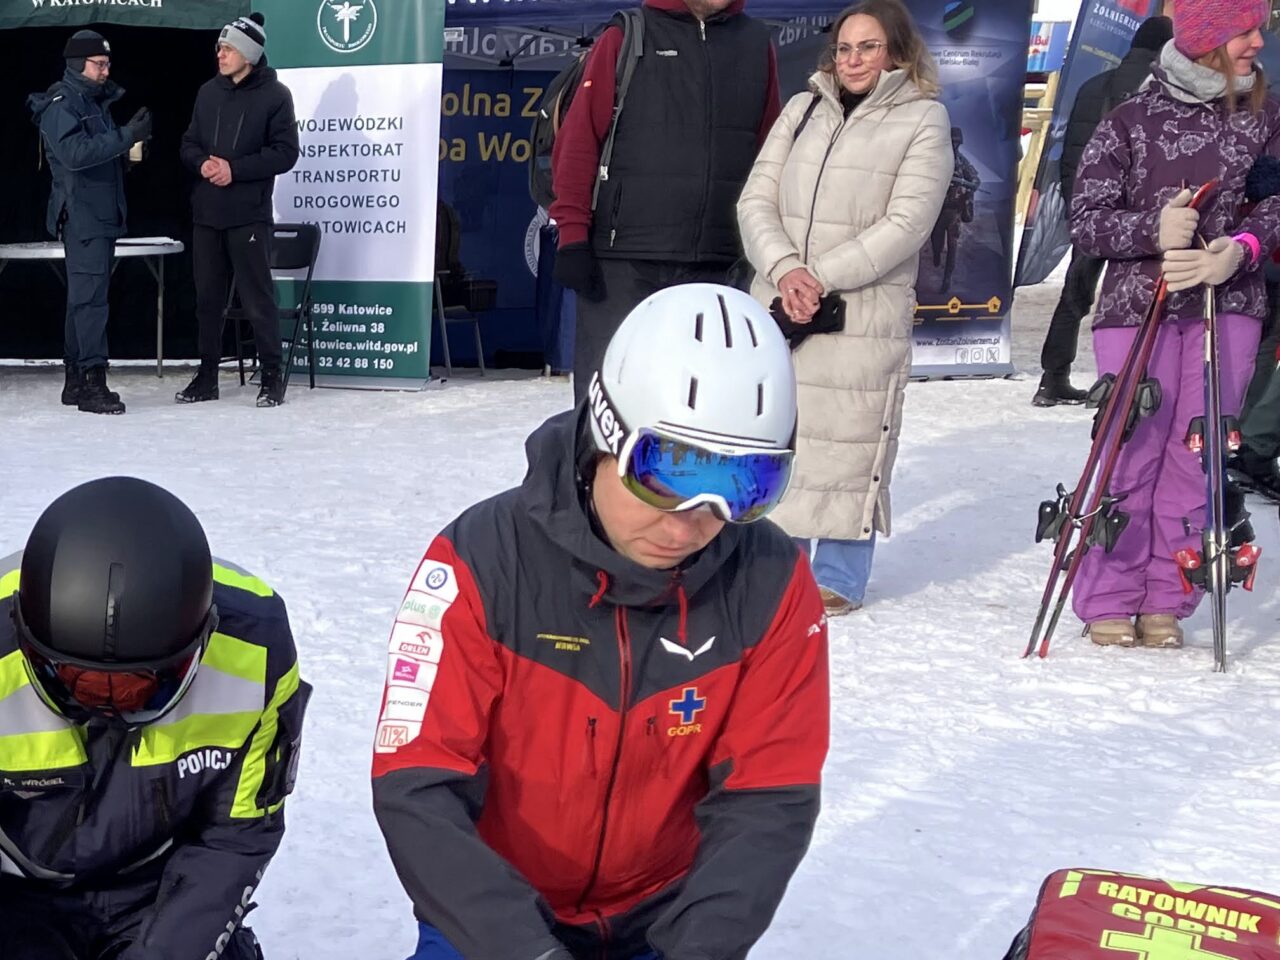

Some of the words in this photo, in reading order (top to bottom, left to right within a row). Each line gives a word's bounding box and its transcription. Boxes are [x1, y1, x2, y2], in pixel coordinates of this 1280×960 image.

[442, 83, 510, 117] olna
[295, 114, 404, 133] WOJEWÓDZKI
[299, 142, 404, 158] NSPEKTORAT
[478, 131, 531, 162] Wo
[292, 169, 401, 183] TRANSPORTU
[293, 195, 400, 208] DROGOWEGO
[302, 220, 407, 234] TOWICACH
[338, 304, 393, 315] Katowice
[321, 318, 366, 333] Żeliwna
[370, 322, 385, 333] 38
[281, 339, 418, 354] wtowice.witd.gov.pl
[318, 356, 333, 367] 32
[336, 357, 351, 368] 42
[354, 358, 368, 369] 88
[373, 359, 394, 369] 150
[588, 371, 624, 455] uvex
[403, 599, 426, 615] plus
[400, 643, 429, 655] ORLEN
[381, 727, 406, 746] 1%
[667, 723, 702, 737] GOPR
[176, 750, 238, 779] POLICJ
[1098, 880, 1262, 934] RATOWNIK
[1111, 902, 1238, 942] GOPR
